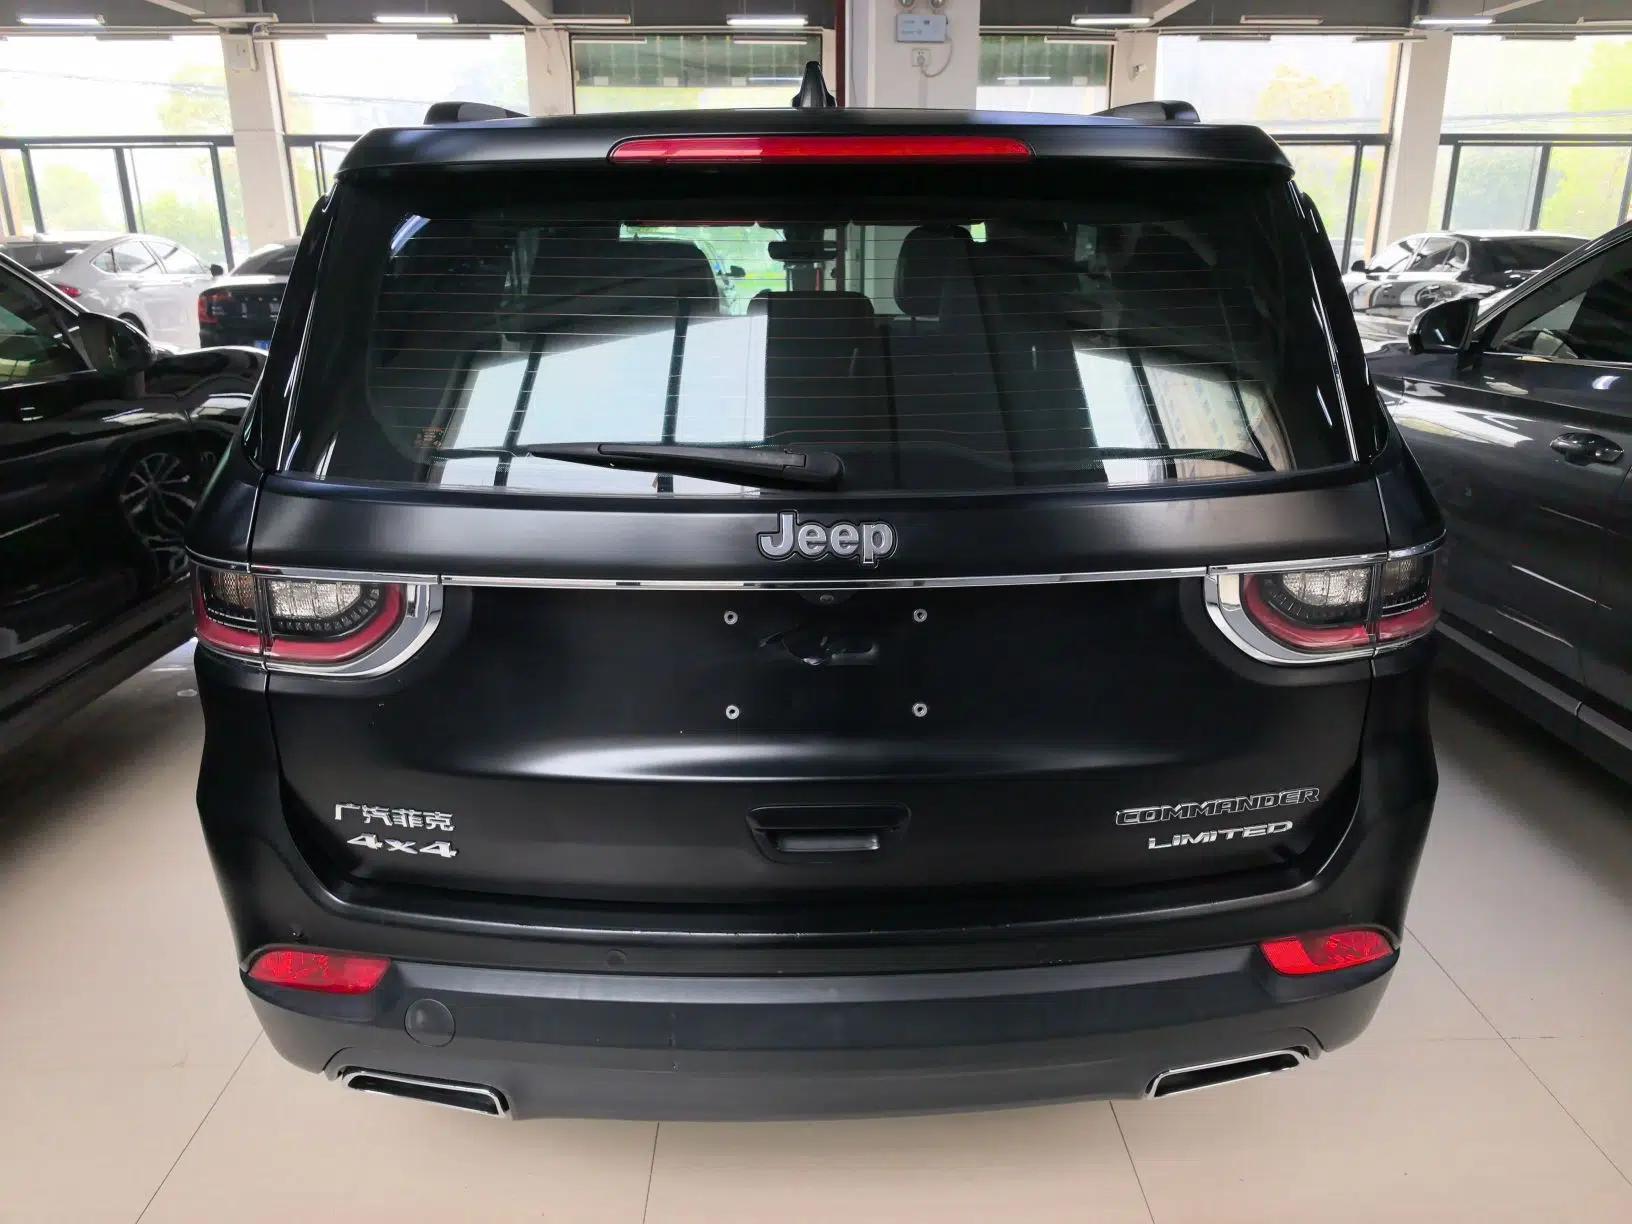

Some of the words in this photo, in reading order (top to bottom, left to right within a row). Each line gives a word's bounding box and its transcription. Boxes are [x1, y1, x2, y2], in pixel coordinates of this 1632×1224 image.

[758, 511, 897, 566] Jeep
[335, 803, 455, 831] 广汽菲克
[1115, 787, 1320, 826] COMMANDER
[1148, 820, 1293, 850] LIMITED
